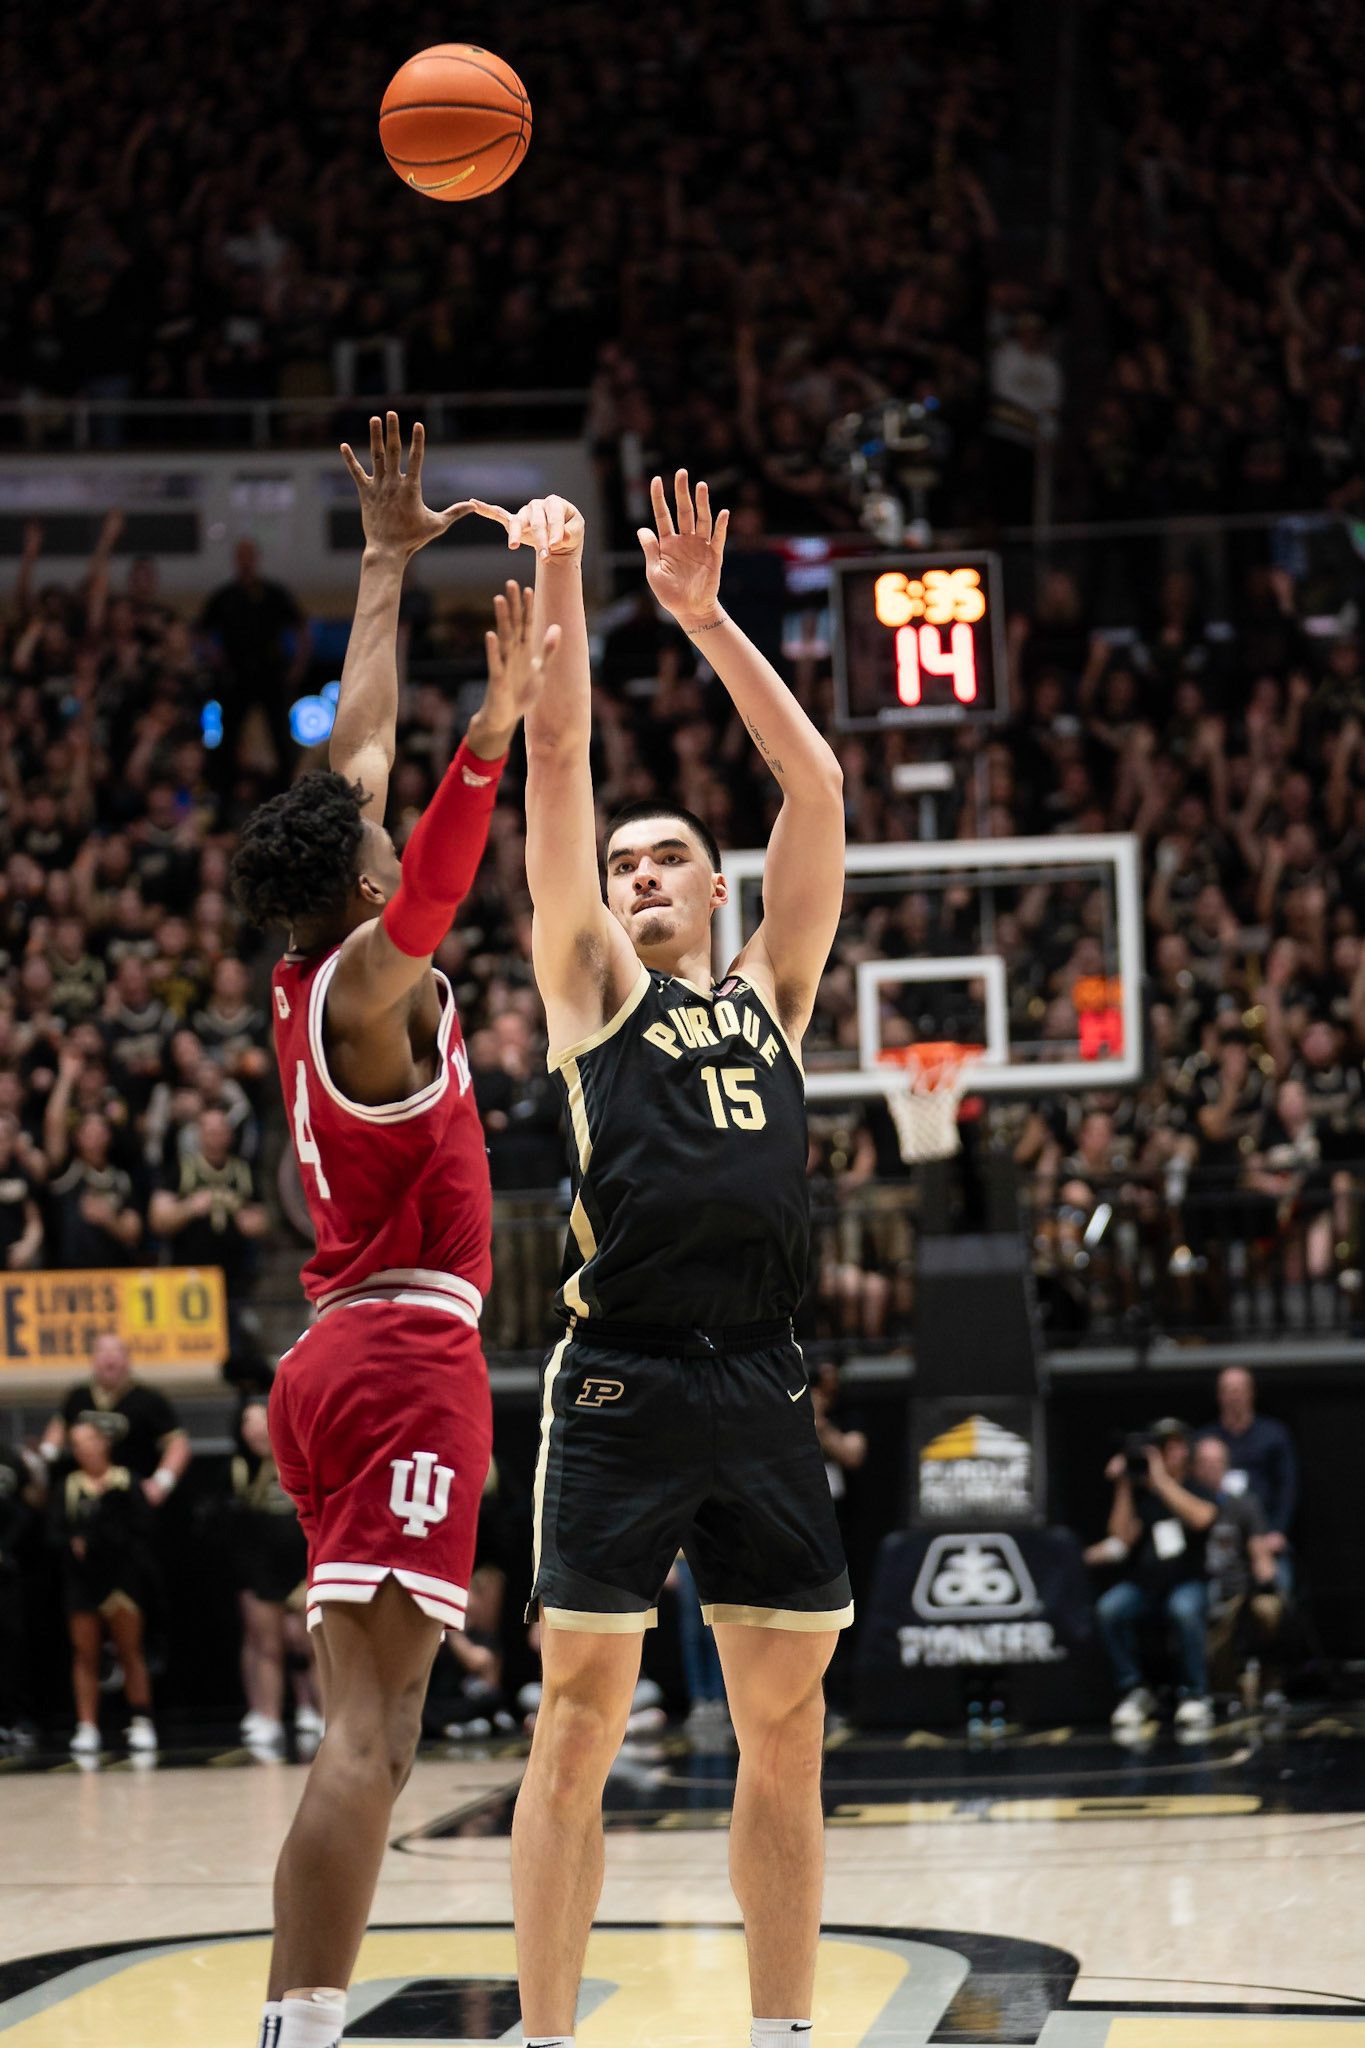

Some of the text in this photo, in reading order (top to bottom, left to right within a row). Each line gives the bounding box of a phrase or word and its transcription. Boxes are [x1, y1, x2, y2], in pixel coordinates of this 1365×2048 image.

[874, 568, 986, 628] 6:35
[895, 621, 978, 707] 14
[642, 1000, 781, 1068] PURDUE
[293, 1060, 331, 1199] 4
[700, 1065, 767, 1131] 15
[898, 1622, 1055, 1666] PIONEER
